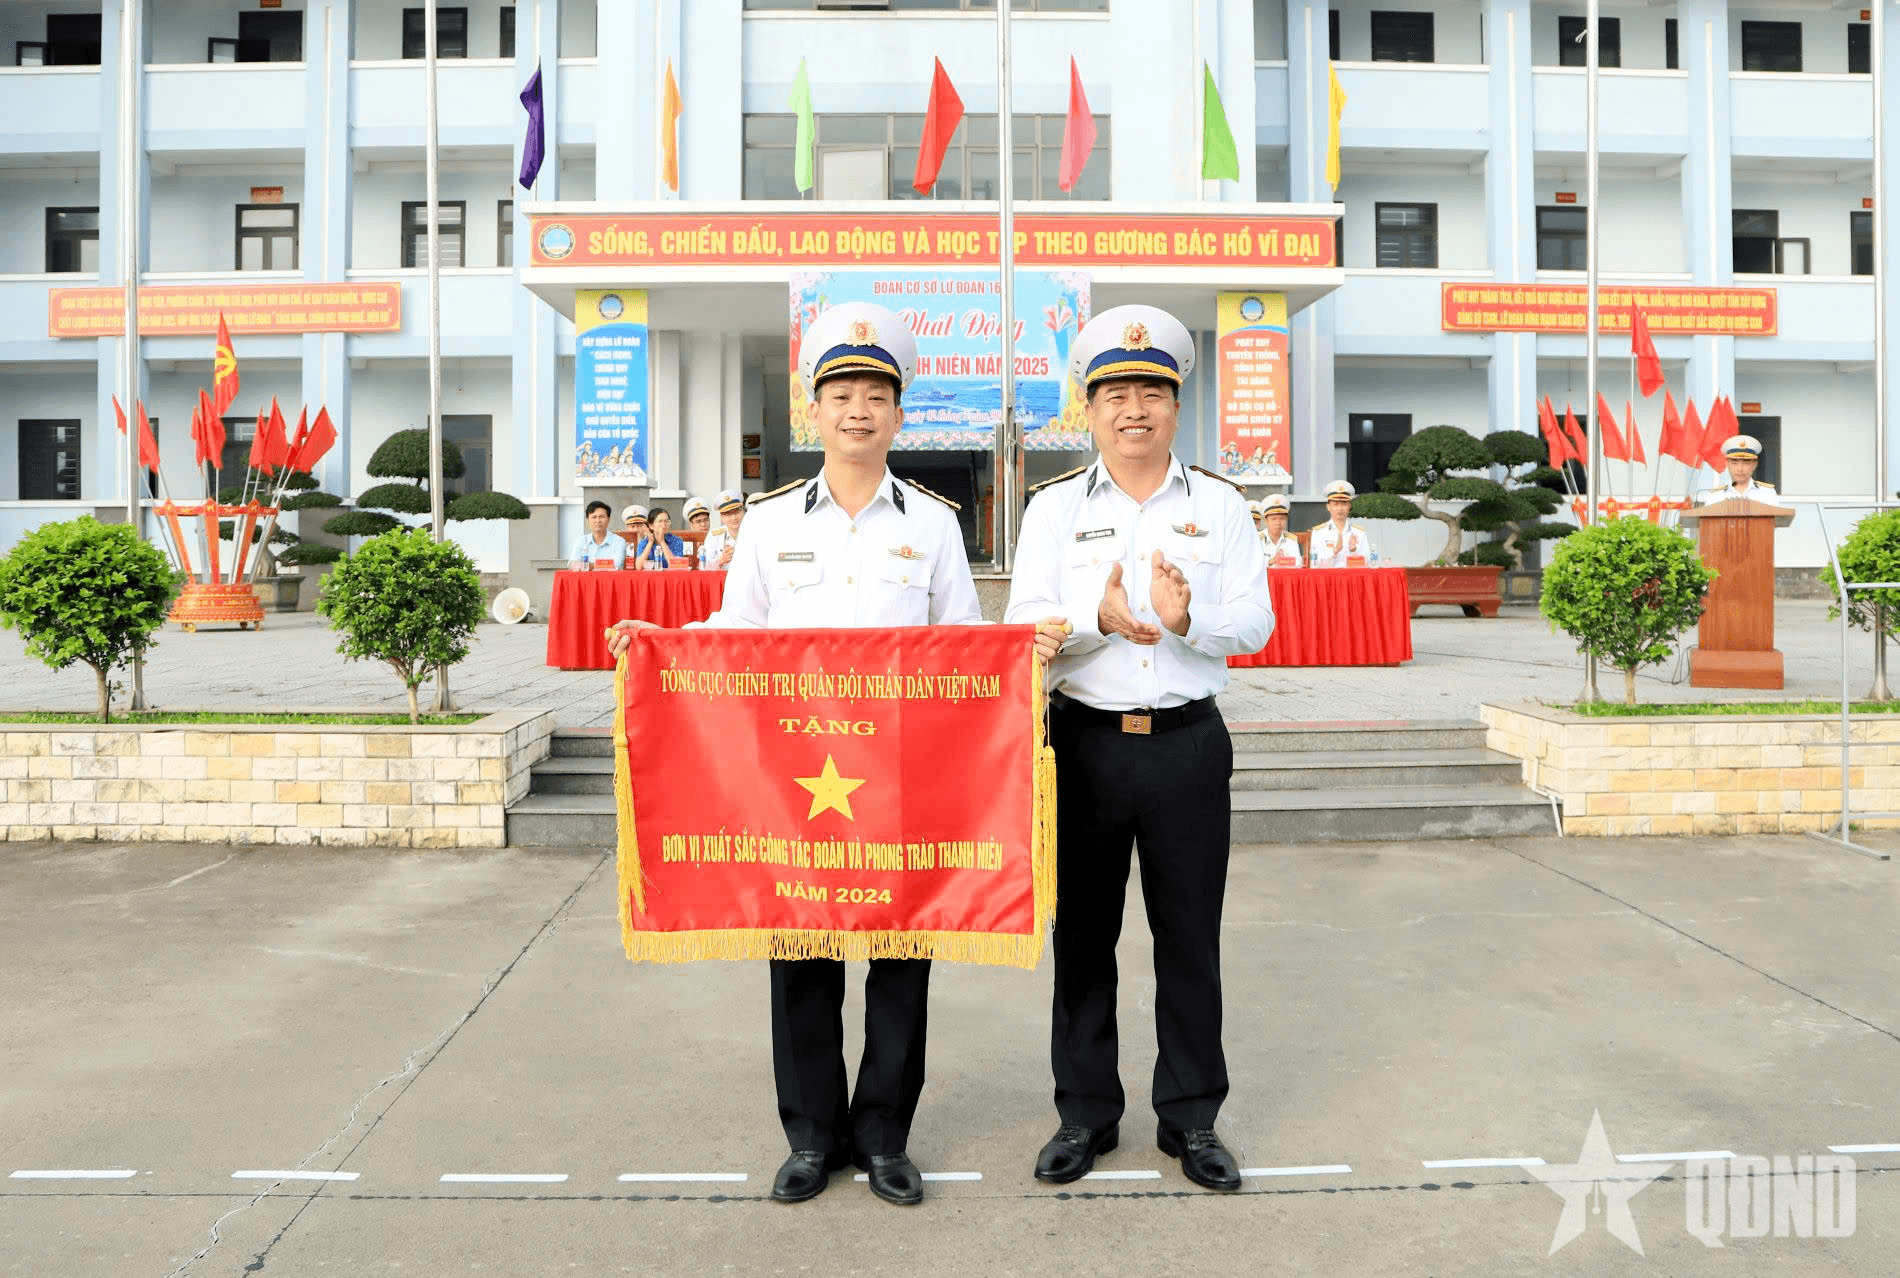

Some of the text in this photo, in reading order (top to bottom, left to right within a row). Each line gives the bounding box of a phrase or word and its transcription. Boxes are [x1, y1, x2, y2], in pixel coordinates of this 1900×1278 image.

[589, 223, 654, 257] SỐNG,
[661, 223, 726, 255] CHIẾN
[733, 222, 783, 256] ĐẤU,
[790, 230, 830, 254] LAO
[836, 225, 896, 259] ĐỘNG
[903, 225, 930, 254] VÀ
[937, 231, 980, 259] HỌC
[987, 231, 1028, 255] TP
[1035, 231, 1088, 255] THEO
[1095, 229, 1168, 255] GƯƠNG
[1174, 225, 1216, 256] BÁC
[1224, 225, 1252, 256] HỒ
[1258, 228, 1278, 256] VĨ
[1284, 233, 1320, 262] ĐẠI
[936, 353, 970, 375] NIÊN
[1015, 357, 1049, 375] 2025
[660, 657, 1001, 705] TỔNG CỤC CHÍNH TRỊ QUÂN ĐỘI NHÂN DÂN VIỆT NAM
[779, 714, 877, 737] TẶNG
[663, 826, 1003, 871] ĐƠN VỊ XUẤT SẮC CÔNG TÁC ĐOÀN VÀ PHONG TRÀO THANH NIÊN
[775, 880, 893, 904] NĂM 2024
